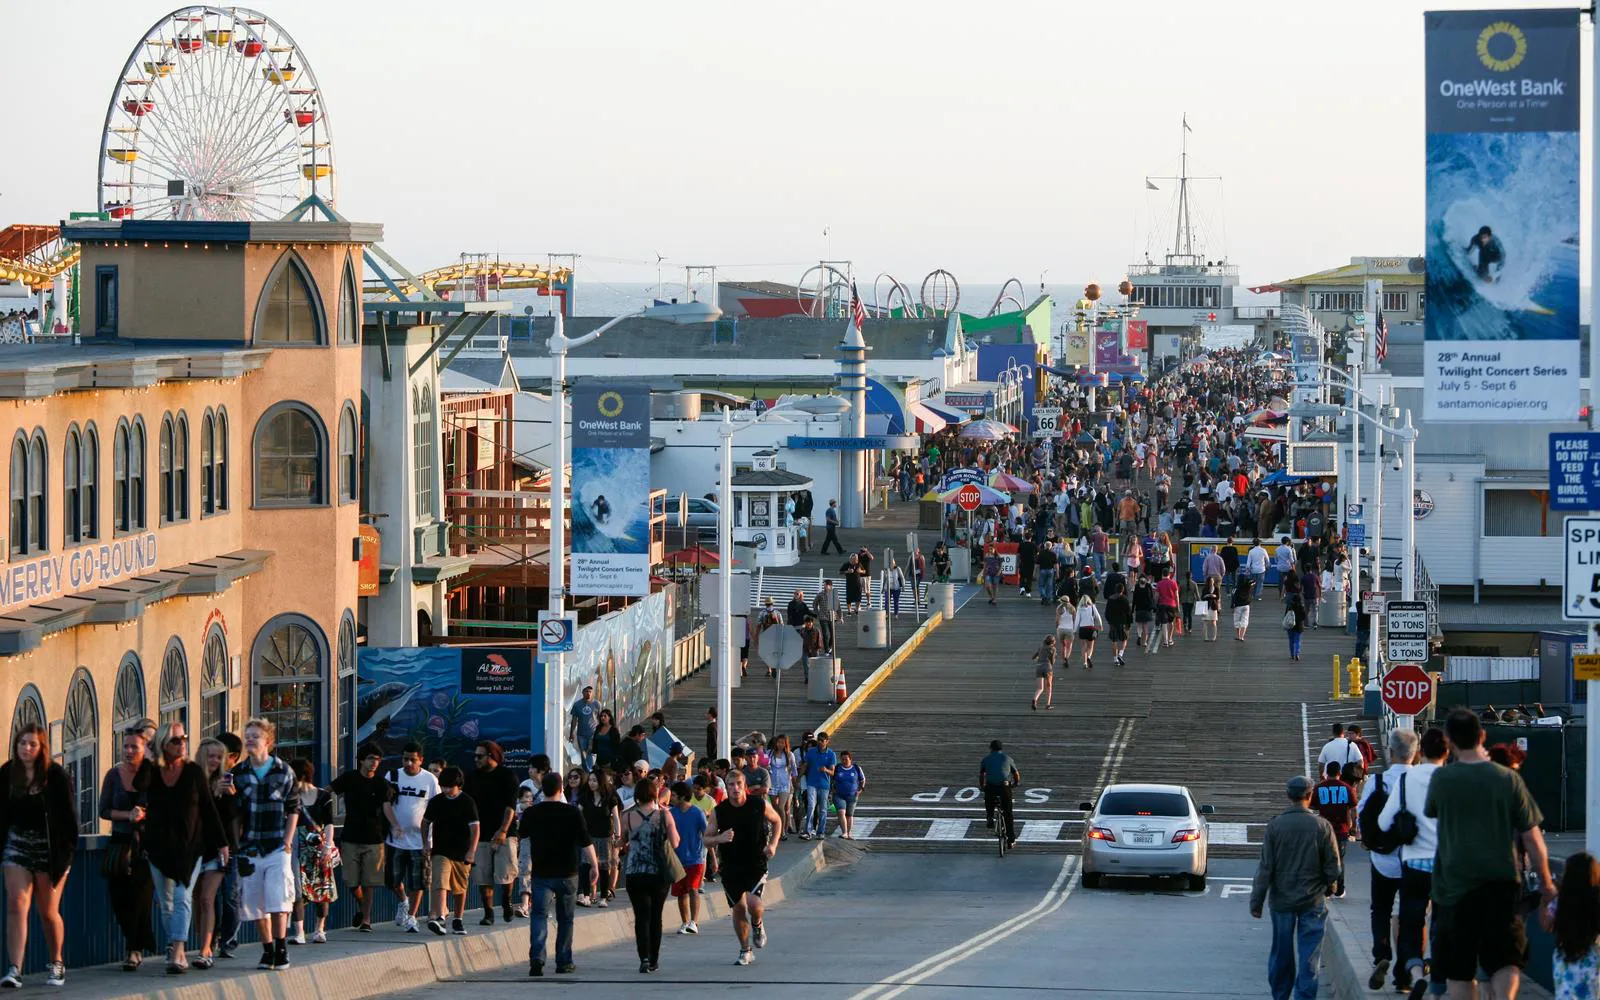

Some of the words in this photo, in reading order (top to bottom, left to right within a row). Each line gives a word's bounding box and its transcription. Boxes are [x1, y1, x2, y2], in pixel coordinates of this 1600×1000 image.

[1439, 79, 1517, 97] OneWest
[1521, 78, 1564, 96] Bank
[1456, 99, 1475, 109] One
[1477, 99, 1507, 109] Person
[1437, 352, 1458, 362] 28th
[1461, 352, 1501, 362] Annual
[1438, 366, 1482, 378] Twilight
[1486, 366, 1530, 376] Concert
[1533, 365, 1568, 376] Series
[1437, 380, 1460, 392] July
[1464, 381, 1471, 391] 5
[1481, 380, 1506, 392] Sept
[1509, 380, 1517, 391] 6
[1437, 398, 1548, 411] santamonicapier.org
[579, 420, 618, 430] OneWest
[620, 421, 642, 430] Bank
[1041, 418, 1054, 430] 66
[804, 439, 827, 447] SANTA
[828, 439, 857, 447] MONICA
[860, 439, 887, 447] POLICE
[1555, 440, 1589, 450] PLEASE
[1556, 451, 1569, 461] DO
[1571, 451, 1589, 461] NOT
[1561, 463, 1584, 472] FEED
[1564, 474, 1581, 484] THE
[1557, 485, 1588, 495] BIRDS.
[960, 492, 980, 503] STOP
[1571, 528, 1600, 543] SP
[0, 554, 65, 607] MERRY
[69, 532, 158, 589] GO-ROUND
[1391, 621, 1400, 629] 10
[1403, 621, 1424, 630] TONS
[1392, 649, 1398, 657] 3
[1400, 649, 1423, 657] TONS
[478, 664, 489, 673] Al
[1385, 681, 1429, 699] STOP
[911, 787, 1053, 803] SOP
